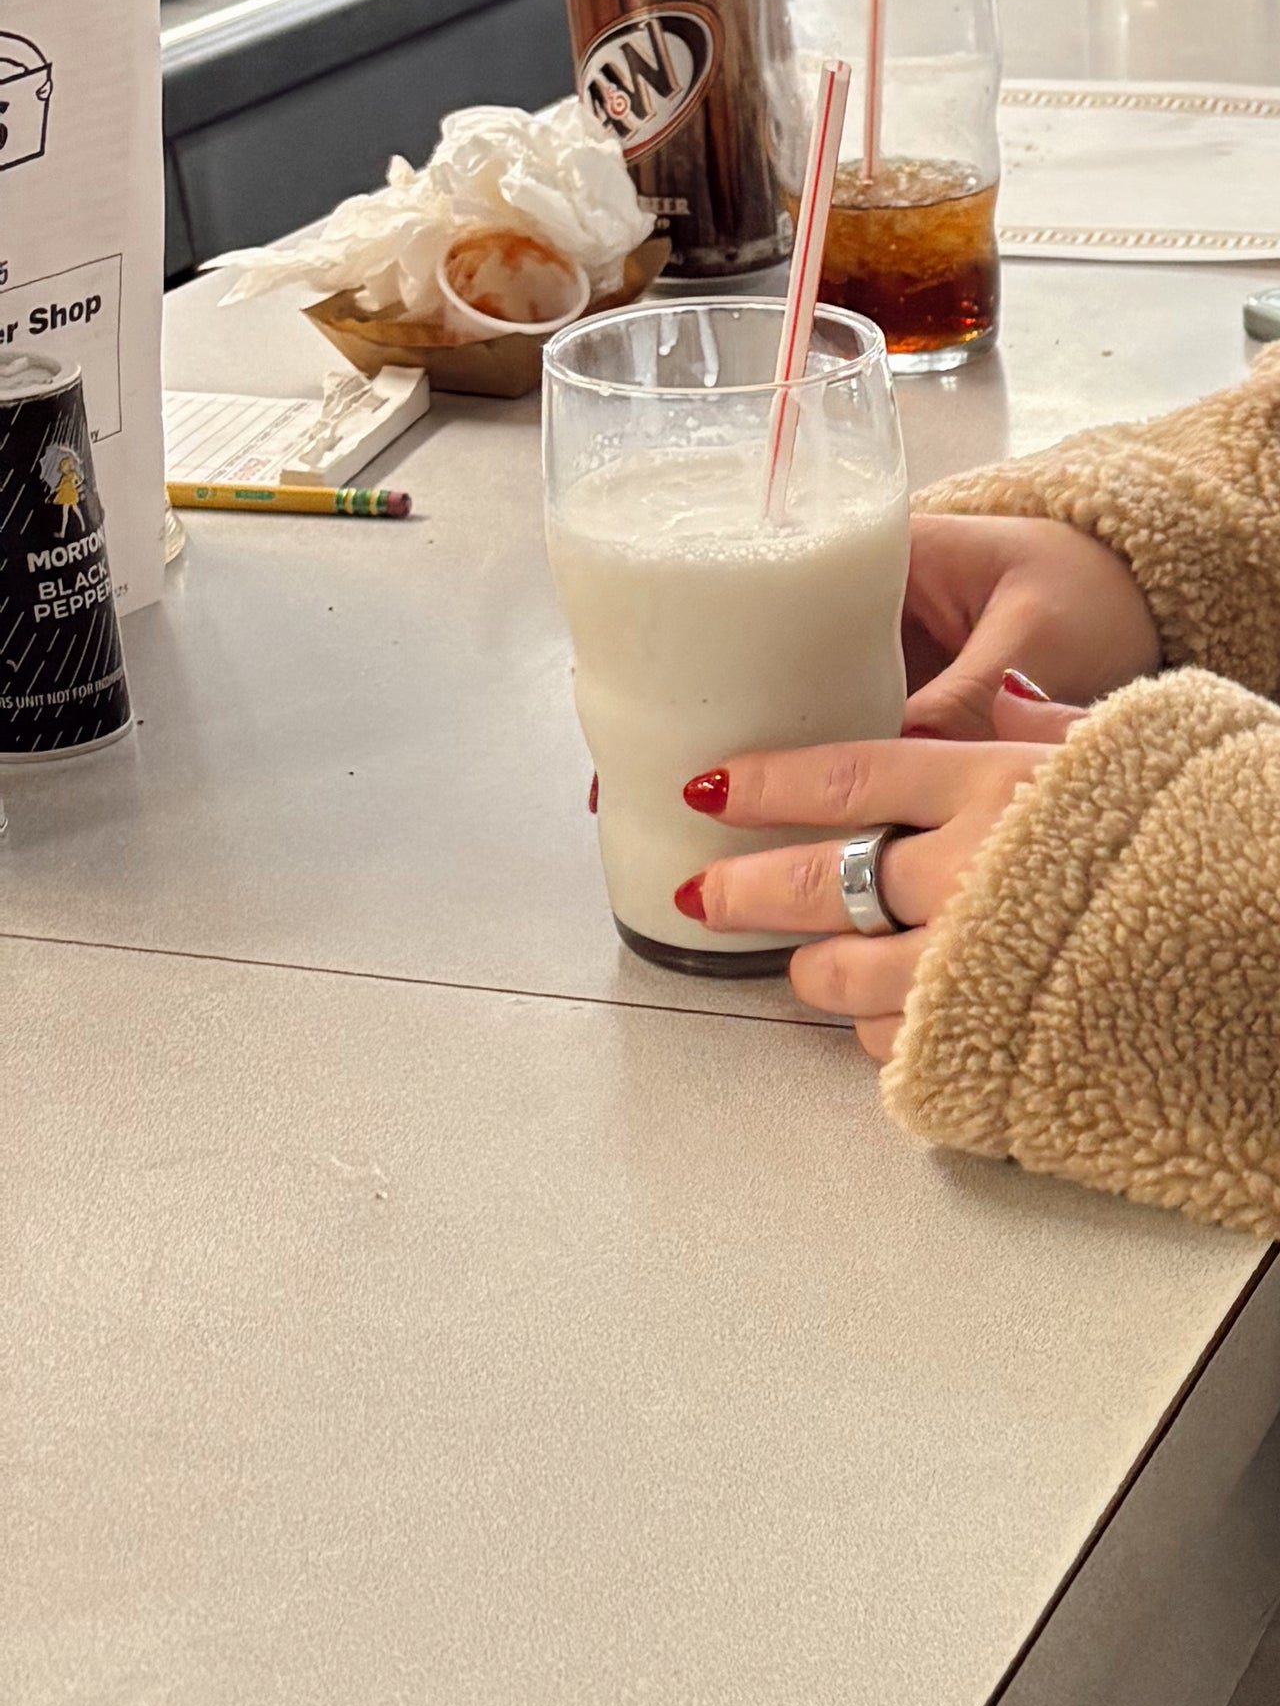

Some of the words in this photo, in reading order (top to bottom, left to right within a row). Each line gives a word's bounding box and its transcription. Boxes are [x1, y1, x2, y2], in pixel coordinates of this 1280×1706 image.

[29, 294, 101, 335] Shop
[26, 525, 105, 573] MORTON
[38, 557, 108, 601] BLACK
[16, 694, 44, 709] UNIT
[46, 689, 70, 705] NOT
[72, 682, 94, 699] FOR
